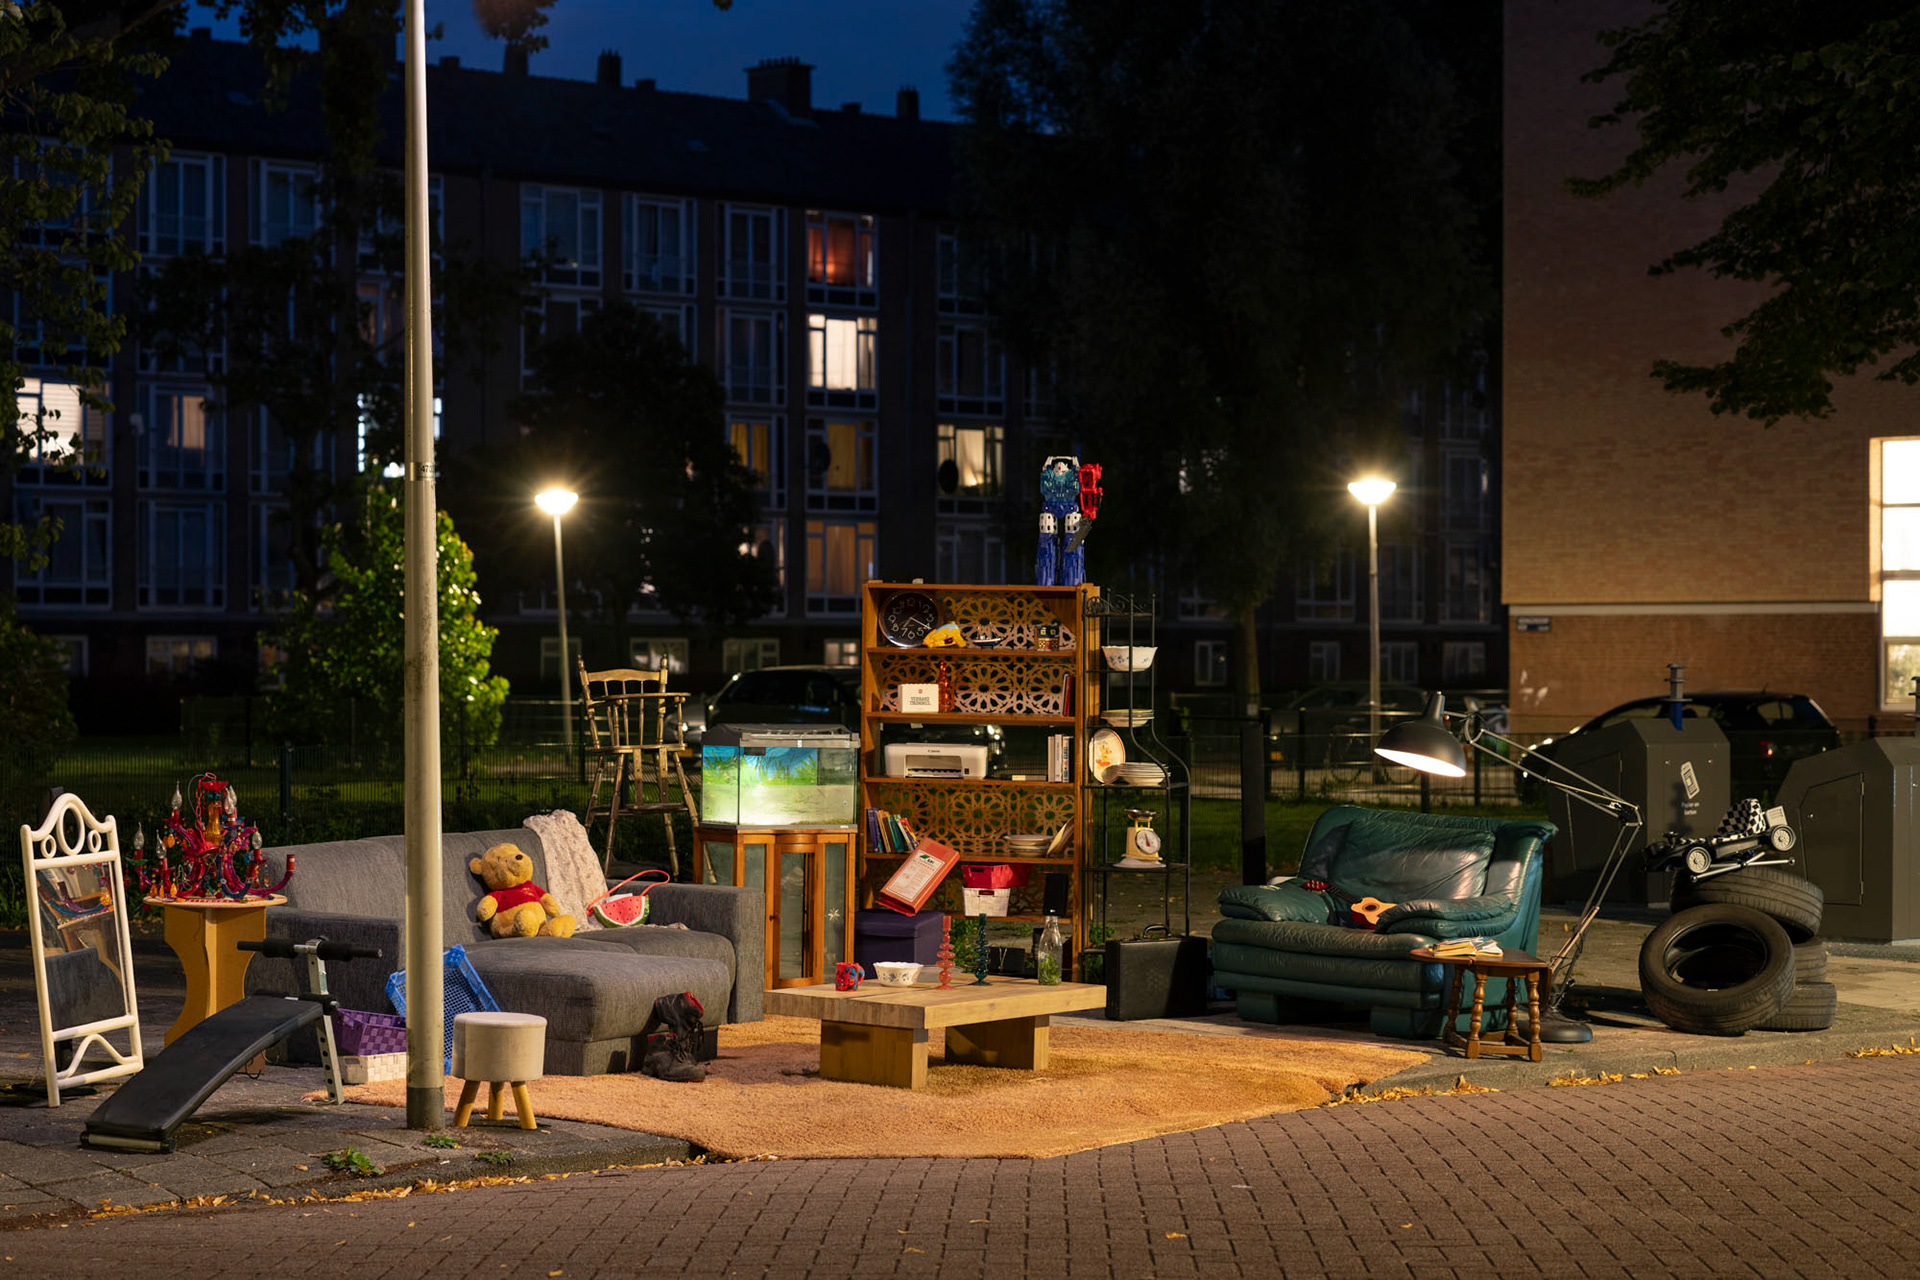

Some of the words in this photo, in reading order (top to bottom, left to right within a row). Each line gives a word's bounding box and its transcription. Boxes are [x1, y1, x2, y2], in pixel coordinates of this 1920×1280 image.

[907, 598, 915, 606] 12
[922, 604, 930, 613] 2
[888, 614, 896, 624] 9
[926, 614, 934, 622] 3
[892, 623, 899, 632] 8
[916, 627, 924, 636] 5
[901, 628, 908, 637] 7
[908, 630, 915, 640] 6
